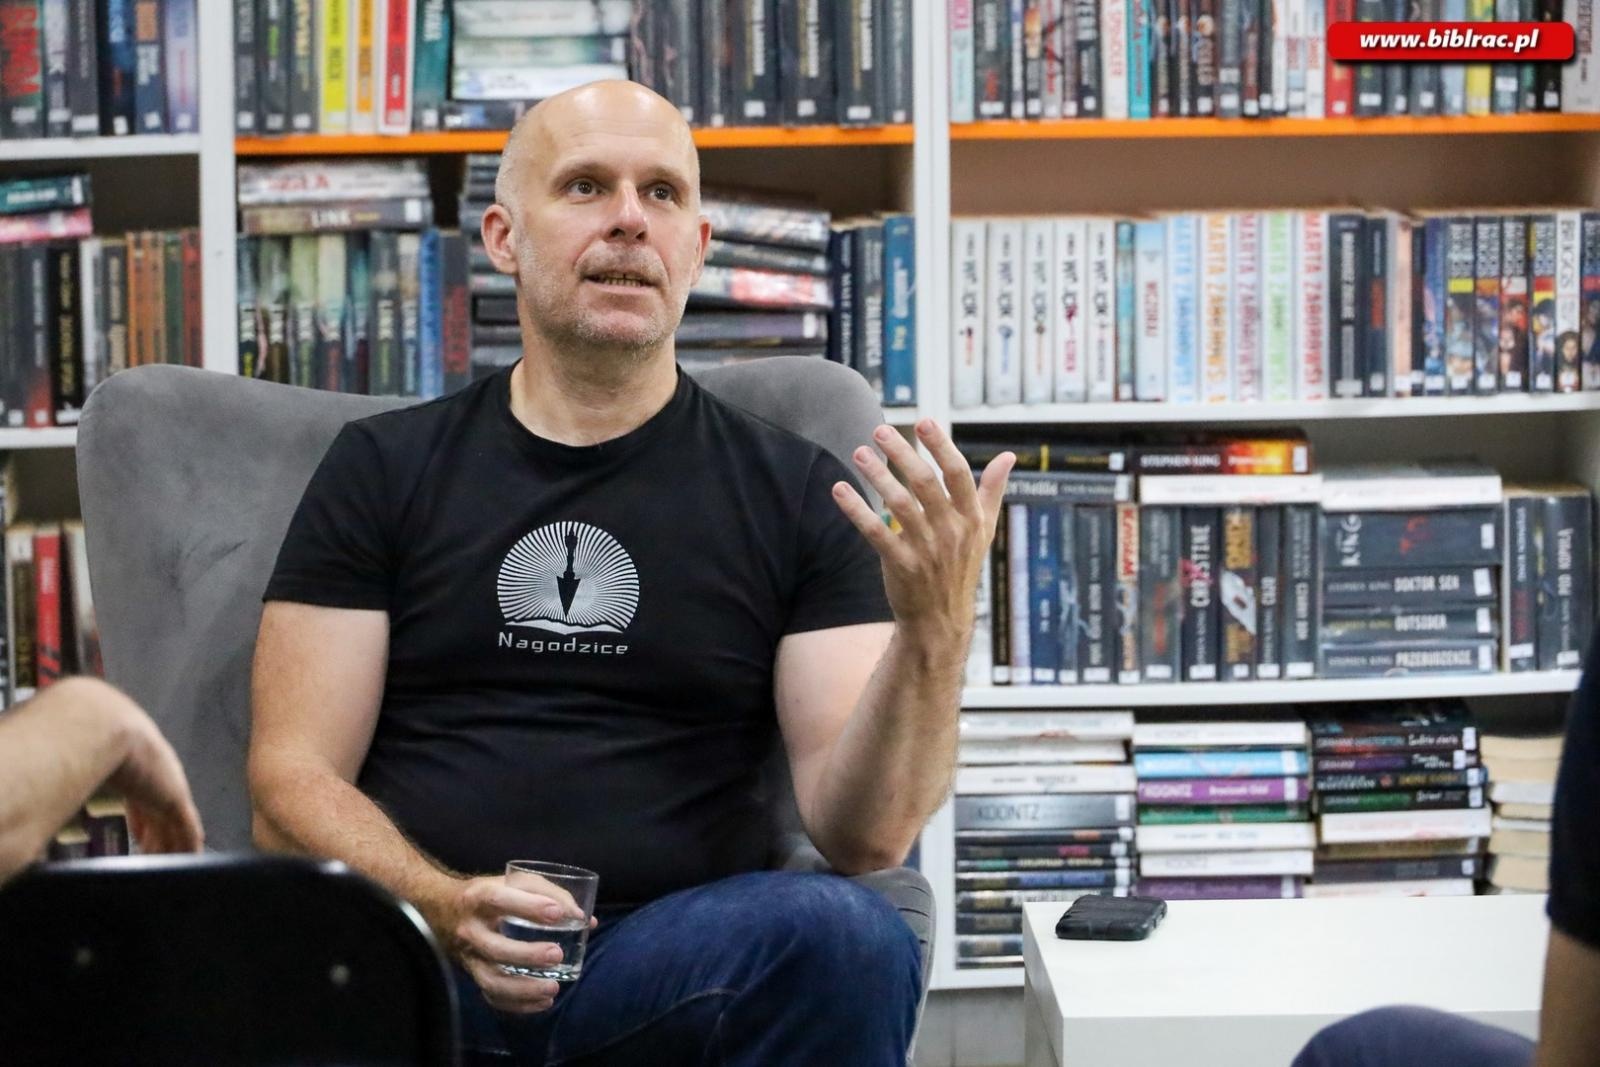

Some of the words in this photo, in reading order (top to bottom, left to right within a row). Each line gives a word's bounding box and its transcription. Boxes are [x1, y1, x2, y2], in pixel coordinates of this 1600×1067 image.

[1305, 214, 1322, 274] MARTA
[1140, 454, 1191, 468] STEPHEN
[1193, 454, 1221, 467] KING
[1340, 514, 1362, 567] KING
[1516, 506, 1527, 552] STEPHEN
[1190, 525, 1211, 608] CHRISTINE
[1516, 554, 1527, 582] KING
[1261, 576, 1277, 606] CUJO
[1394, 575, 1436, 592] DOKTOR
[1438, 574, 1460, 591] SEN
[1558, 574, 1572, 596] POD
[1394, 614, 1447, 632] OUTSIDER
[498, 631, 629, 655] Nagodzice
[1395, 650, 1472, 667] PRZEBUDZENIE
[978, 804, 1041, 821] KOONTZ
